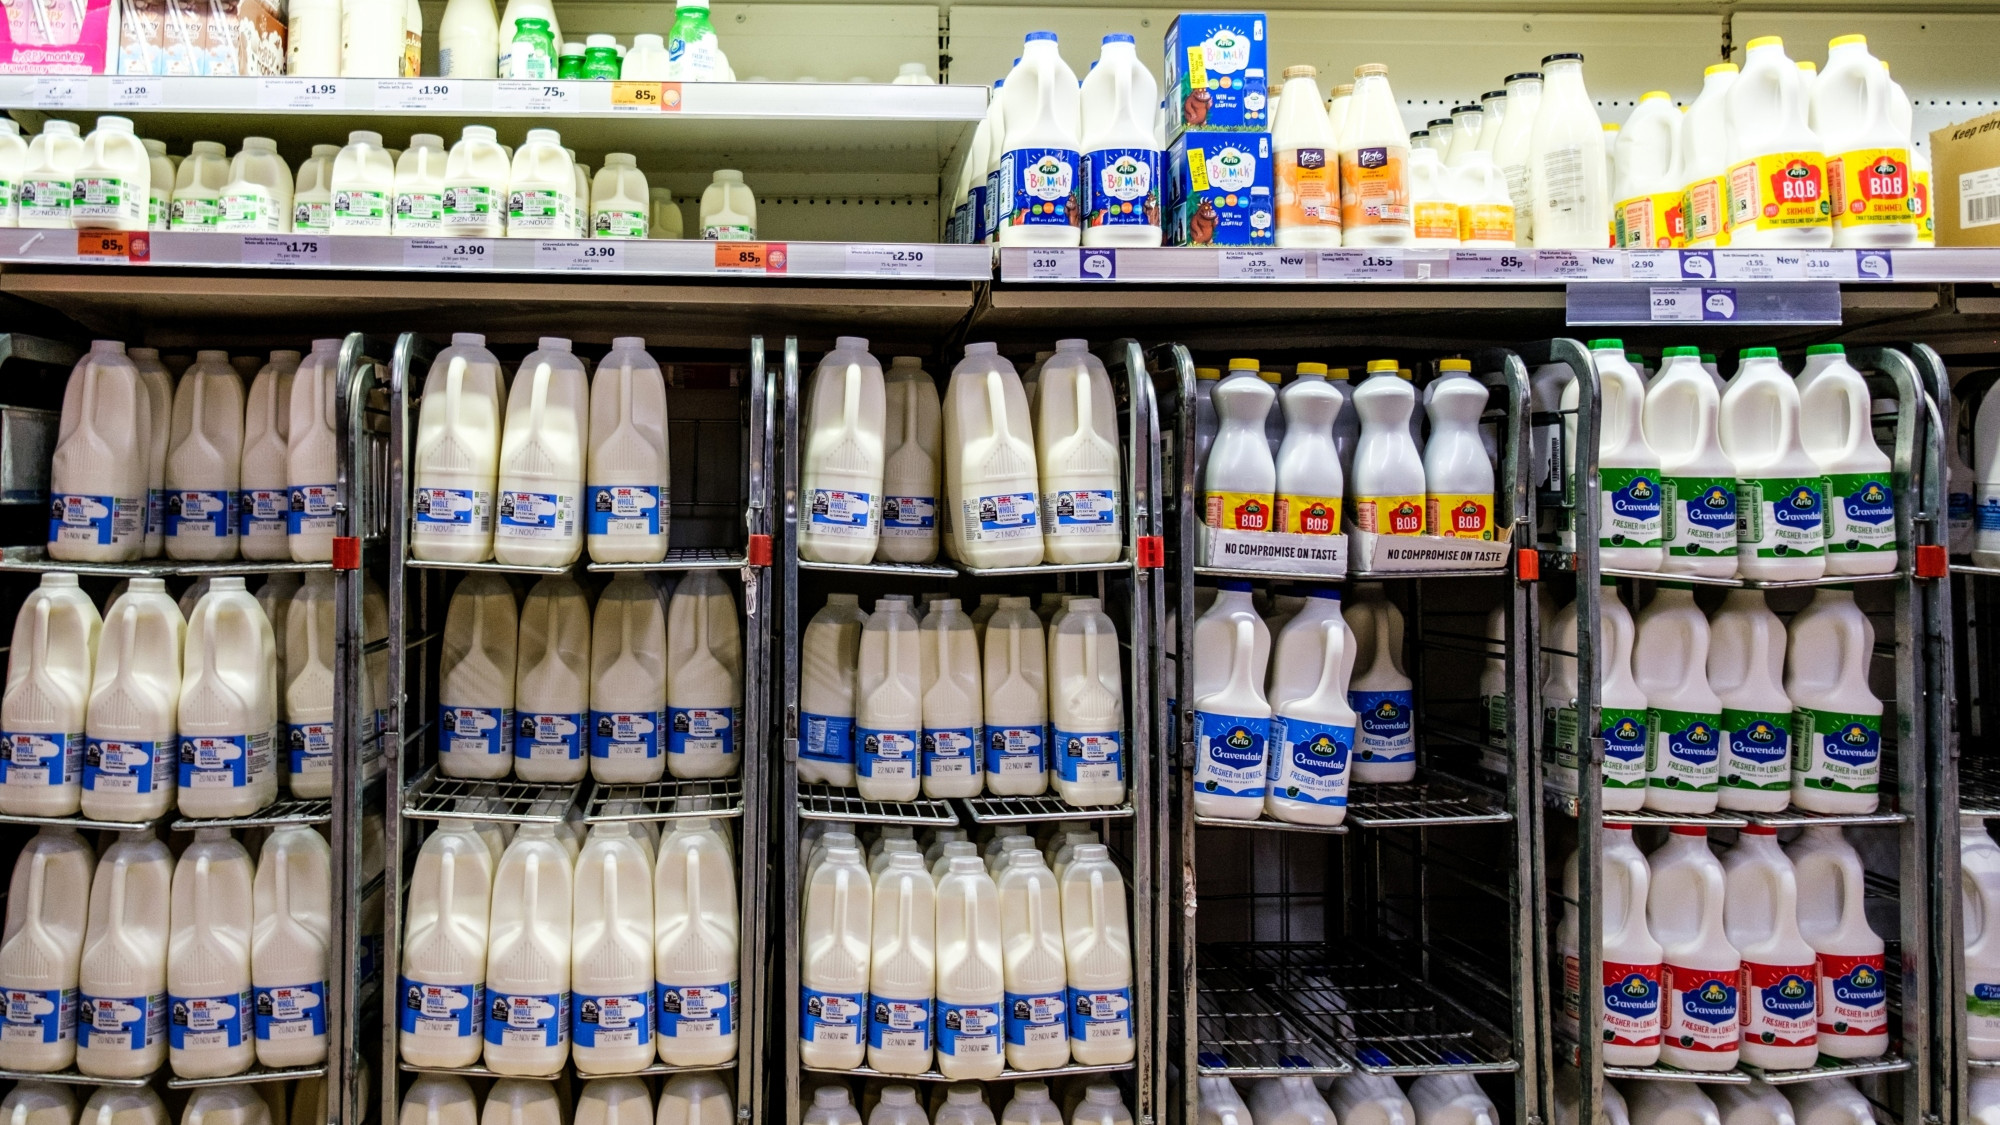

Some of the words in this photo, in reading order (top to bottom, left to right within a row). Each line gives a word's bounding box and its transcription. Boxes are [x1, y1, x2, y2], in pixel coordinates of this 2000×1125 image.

[124, 87, 146, 96] £1.20
[306, 84, 336, 94] £1.95
[418, 86, 448, 95] £1.90
[543, 86, 565, 99] 75p
[635, 90, 656, 104] 85p
[1951, 126, 1977, 141] Keep
[1041, 166, 1058, 174] Arla
[1119, 166, 1134, 174] Arla
[1790, 168, 1806, 176] Arla
[1876, 165, 1893, 174] Arla
[1782, 180, 1816, 199] B.O.B
[1870, 177, 1902, 195] B.O.B
[1786, 206, 1815, 215] SKIMMED
[102, 240, 123, 252] 85p
[287, 242, 318, 253] £1.75
[454, 246, 485, 255] £3.90
[584, 248, 615, 257] £3.90
[892, 252, 923, 262] £2.50
[739, 252, 760, 264] 85p
[1280, 256, 1303, 265] New
[1362, 257, 1393, 267] £1.85
[1500, 256, 1523, 268] 85p
[1592, 256, 1614, 265] New
[1776, 256, 1799, 265] New
[1033, 259, 1056, 268] £3.10
[1806, 260, 1829, 268] £3.10
[1653, 298, 1676, 306] £2.90
[1634, 489, 1650, 497] Arla
[1867, 493, 1882, 501] Arla
[830, 502, 847, 510] WHOLE
[1709, 497, 1725, 506] Arla
[515, 504, 532, 512] WHOLE
[998, 506, 1015, 514] WHOLE
[1241, 515, 1262, 527] B.O.B
[1306, 518, 1328, 530] B.O.B
[1396, 517, 1418, 530] B.O.B
[1458, 516, 1480, 529] B.O.B
[1612, 519, 1638, 530] FRESHER
[1687, 528, 1713, 539] FRESHER
[1775, 529, 1801, 539] FRESHER
[1846, 524, 1872, 534] FRESHER
[1225, 543, 1236, 554] NO
[1238, 544, 1295, 558] COMPROMISE
[1297, 548, 1309, 559] ON
[1311, 548, 1337, 560] TASTE
[1387, 549, 1399, 559] NO
[1401, 550, 1458, 560] COMPROMISE
[1460, 550, 1472, 560] ON
[1475, 551, 1502, 562] TASTE
[1363, 720, 1409, 730] Cravendale
[1620, 730, 1635, 738] Arla
[1691, 733, 1707, 741] Arla
[1752, 733, 1771, 741] Arla
[1847, 734, 1864, 743] Arla
[1231, 736, 1249, 746] Arla
[1362, 737, 1385, 746] FRESHER
[1314, 745, 1332, 754] Arla
[1671, 742, 1717, 756] Cravendale
[1732, 742, 1785, 755] Cravendale
[1826, 743, 1876, 757] Cravendale
[1212, 747, 1261, 762] Cravendale
[1294, 752, 1344, 770] Cravendale
[1729, 760, 1756, 772] FRESHER
[1207, 765, 1232, 778] FRESHER
[1242, 770, 1262, 780] LONGER
[1667, 761, 1693, 774] FRESHER
[1822, 762, 1850, 775] FRESHER
[1289, 770, 1315, 785] FRESHER
[1324, 779, 1344, 788] LONGER
[1628, 986, 1645, 994] Arla
[1785, 987, 1801, 995] Arla
[1705, 992, 1723, 1000] Arla
[1607, 994, 1657, 1009] Cravendale
[1765, 997, 1814, 1010] Cravendale
[1685, 1001, 1736, 1015] Cravendale
[1834, 1006, 1862, 1018] FRESHER
[1603, 1013, 1631, 1027] FRESHER
[1762, 1016, 1790, 1028] FRESHER
[1681, 1020, 1709, 1033] FRESHER
